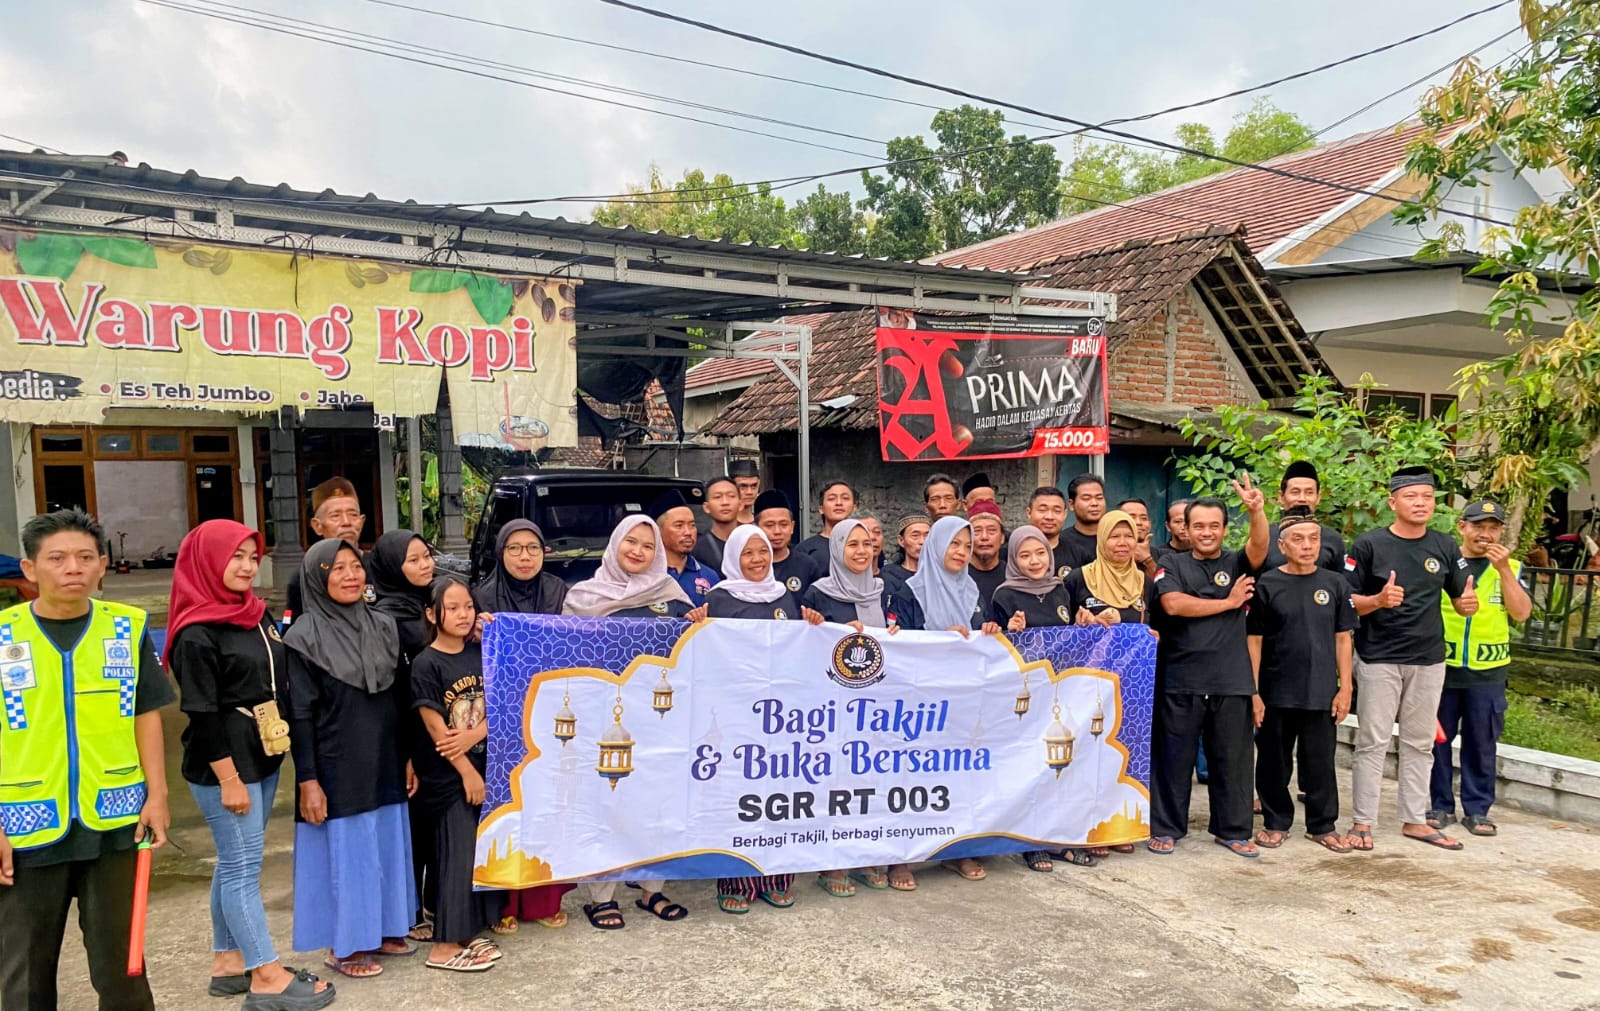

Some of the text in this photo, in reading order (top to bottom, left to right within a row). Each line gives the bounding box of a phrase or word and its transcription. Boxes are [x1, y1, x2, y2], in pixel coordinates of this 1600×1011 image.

[0, 277, 536, 382] Warung Kopi
[1071, 338, 1099, 355] BARU
[119, 381, 272, 402] Es Teh Jumbo
[965, 365, 1083, 414] PRIMA
[975, 415, 996, 430] HADIR
[997, 412, 1020, 426] DALAM
[752, 698, 949, 743] Bagi Takjil
[691, 740, 992, 784] & Buka Bersama
[737, 785, 950, 822] SGR RT 003
[732, 825, 955, 848] Berbagi Takjil, berbagi senyuman
